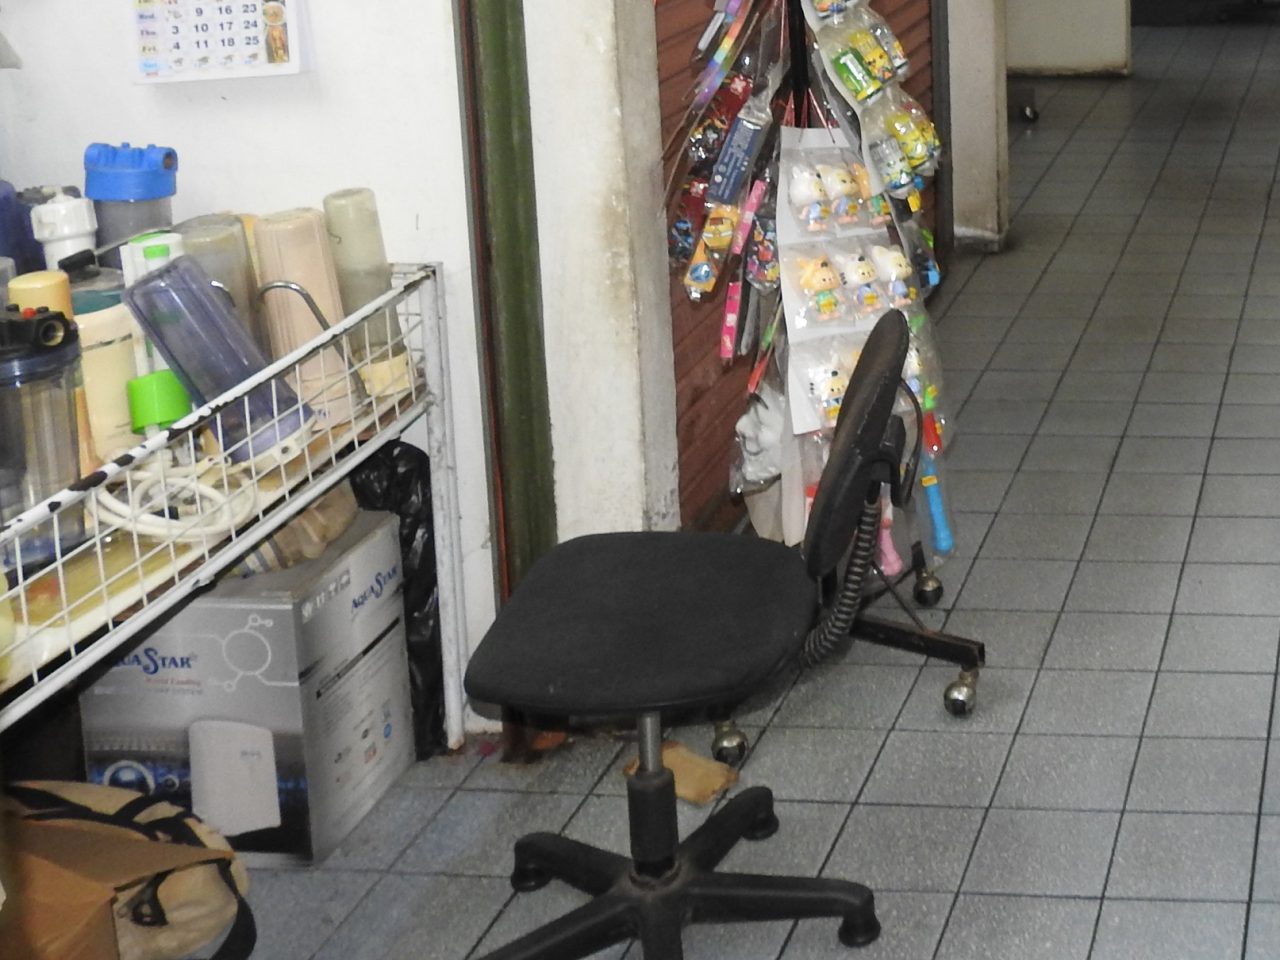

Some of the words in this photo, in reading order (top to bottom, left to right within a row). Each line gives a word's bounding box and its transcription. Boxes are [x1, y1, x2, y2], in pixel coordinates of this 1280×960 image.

[196, 8, 203, 16] 9
[218, 6, 232, 15] 16
[242, 4, 257, 13] 23
[172, 25, 179, 35] 3
[194, 23, 209, 33] 10
[219, 22, 233, 31] 17
[243, 20, 258, 29] 24
[173, 41, 180, 50] 4
[195, 40, 209, 49] 11
[221, 38, 235, 47] 18
[245, 36, 259, 45] 25
